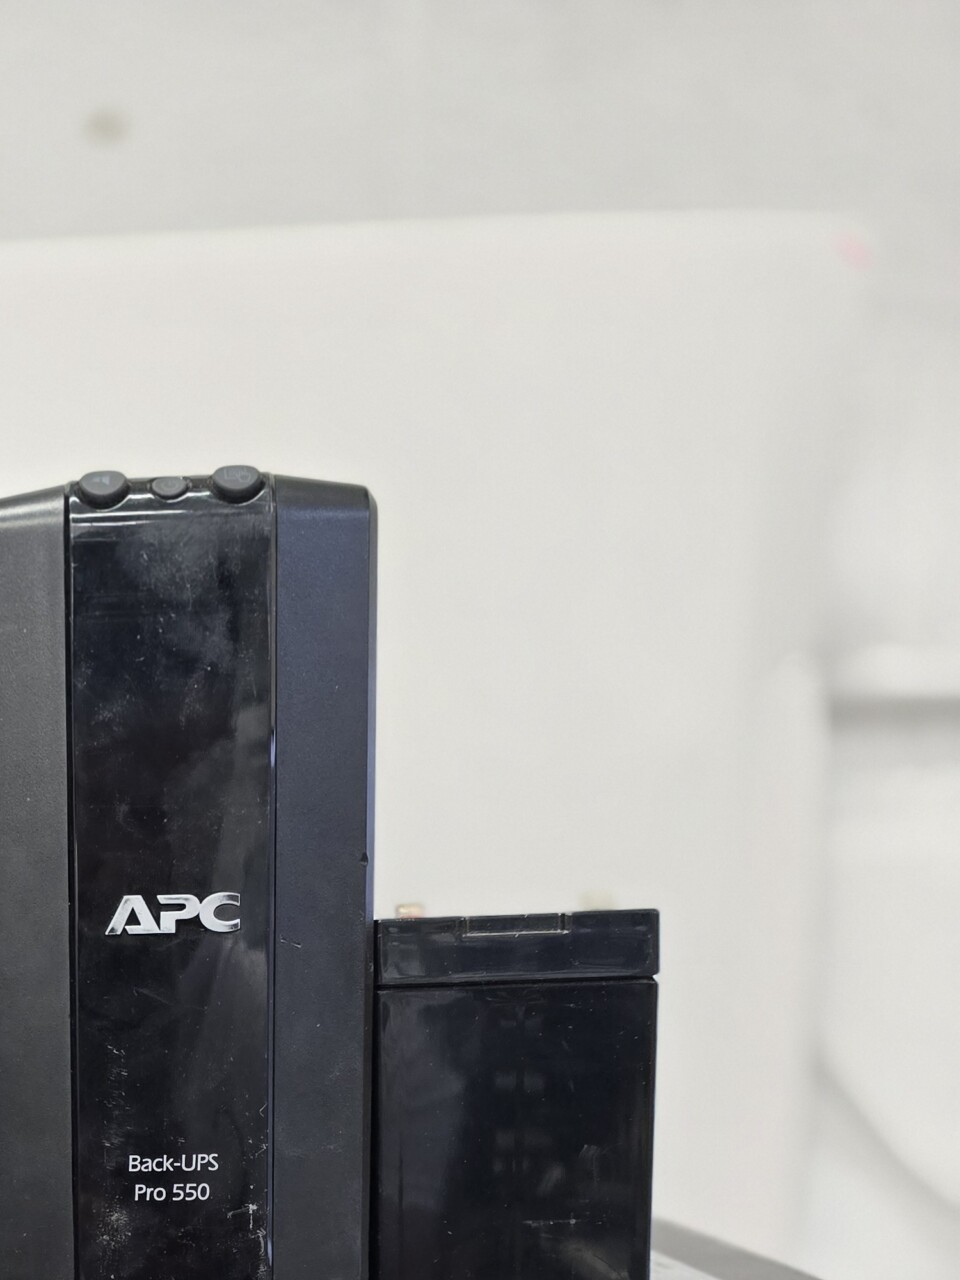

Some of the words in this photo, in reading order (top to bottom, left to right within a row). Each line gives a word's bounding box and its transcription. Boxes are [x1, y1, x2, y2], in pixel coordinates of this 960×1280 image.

[105, 892, 241, 935] APC
[128, 1153, 219, 1172] Back-UPS
[134, 1184, 166, 1201] Pro
[172, 1183, 210, 1200] 550
